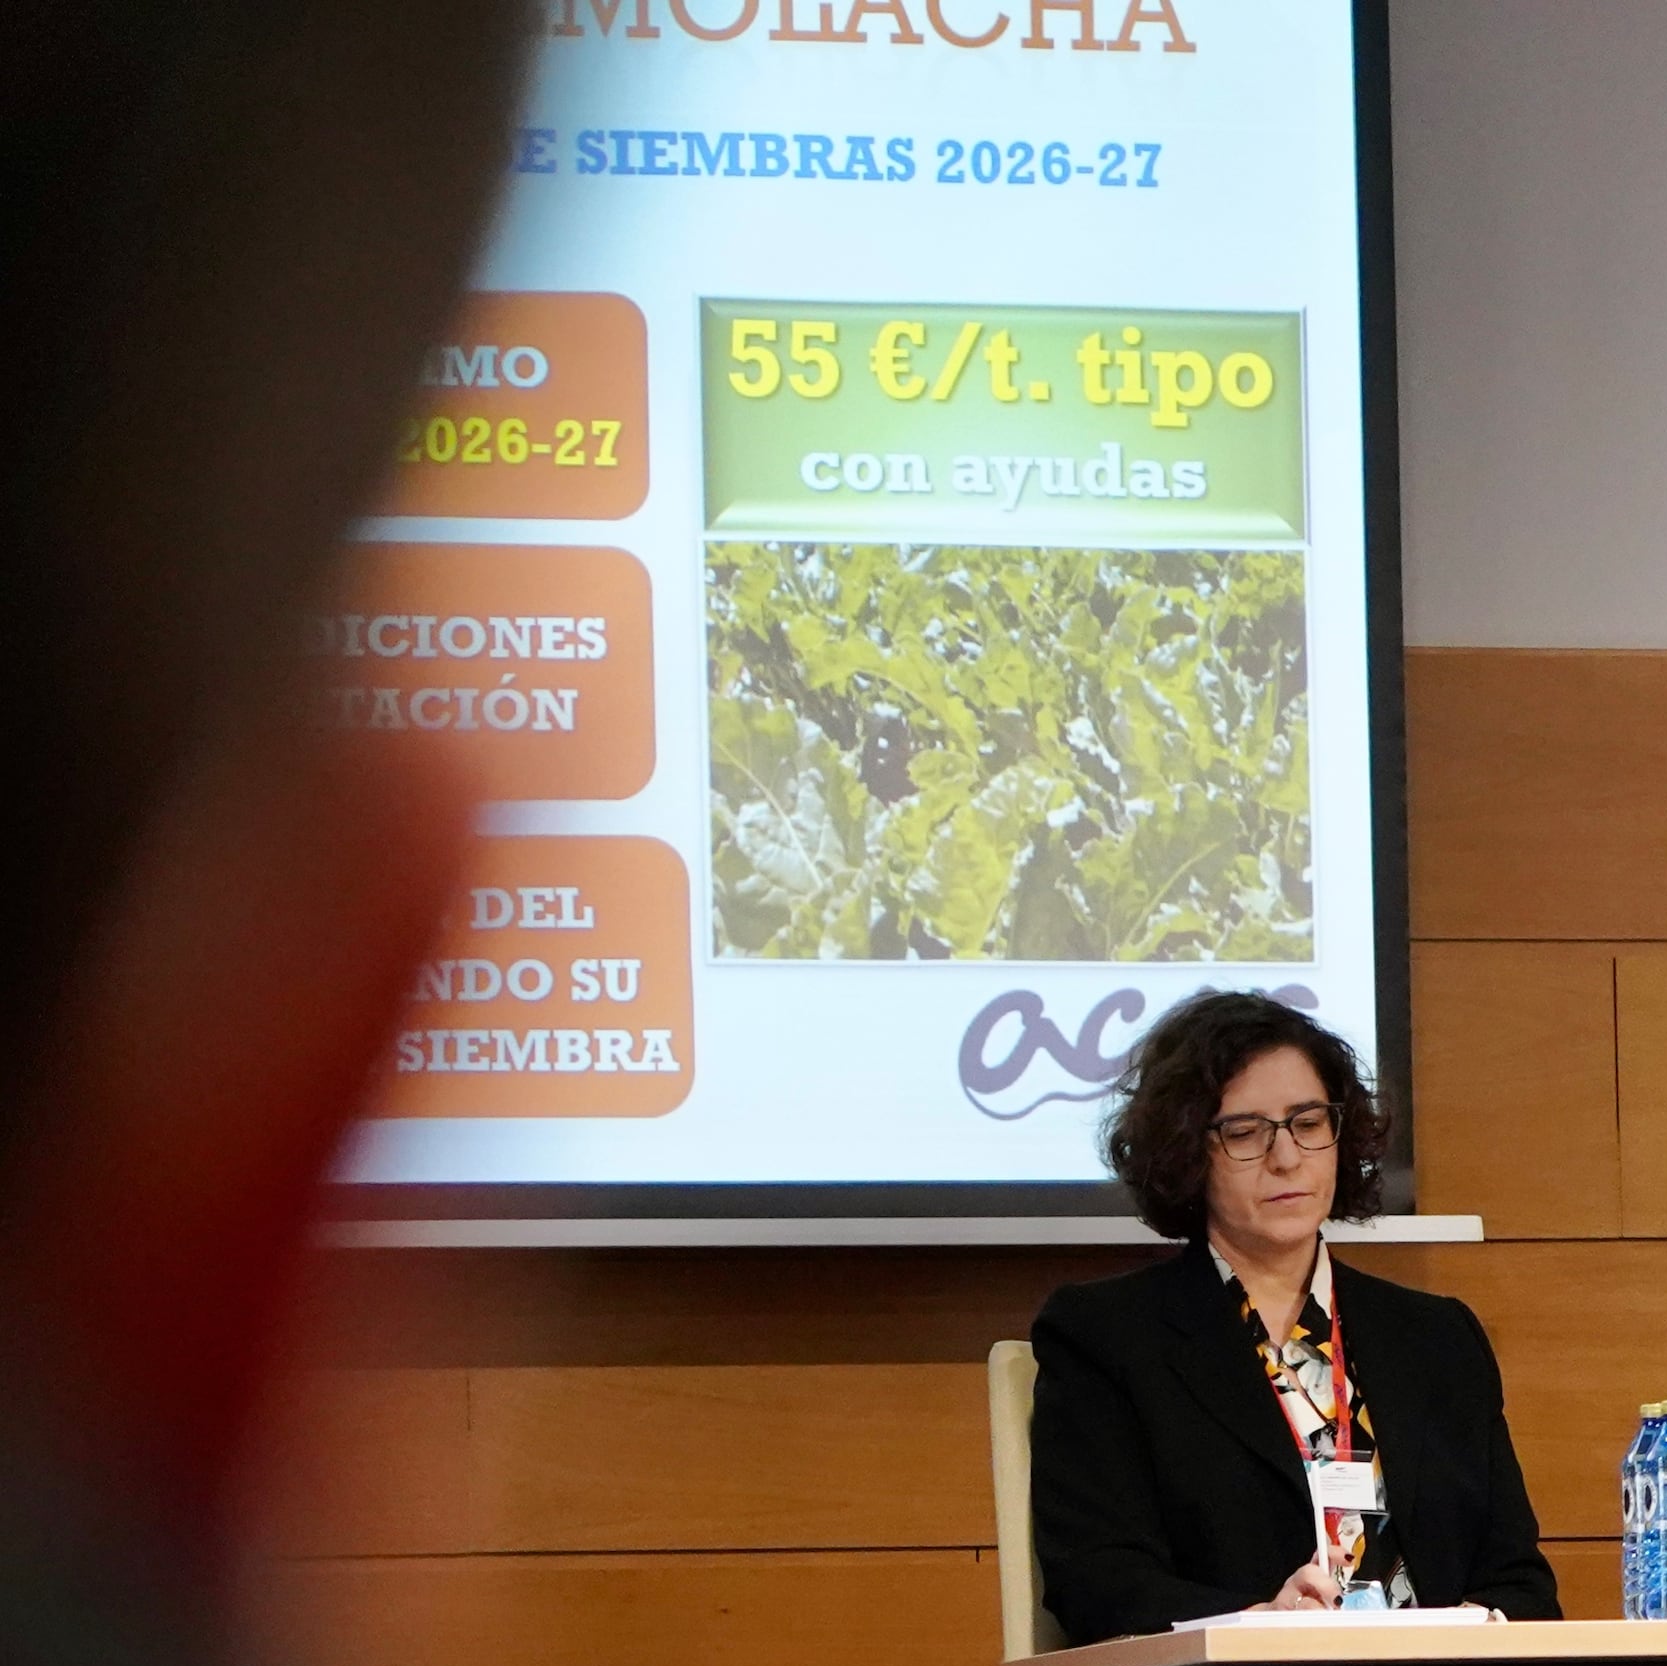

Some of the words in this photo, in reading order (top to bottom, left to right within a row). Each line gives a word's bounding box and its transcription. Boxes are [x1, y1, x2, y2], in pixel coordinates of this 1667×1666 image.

[516, 128, 557, 174] E
[575, 130, 916, 182] SIEMBRAS
[936, 141, 1161, 187] 2026-27
[728, 318, 841, 399] 55
[870, 320, 1049, 402] €/t.
[1077, 326, 1274, 427] tipo
[801, 450, 931, 493] con
[953, 443, 1207, 509] ayudas
[470, 887, 594, 928] DEL
[571, 959, 640, 1000] SU
[397, 1029, 680, 1071] SIEMBRA
